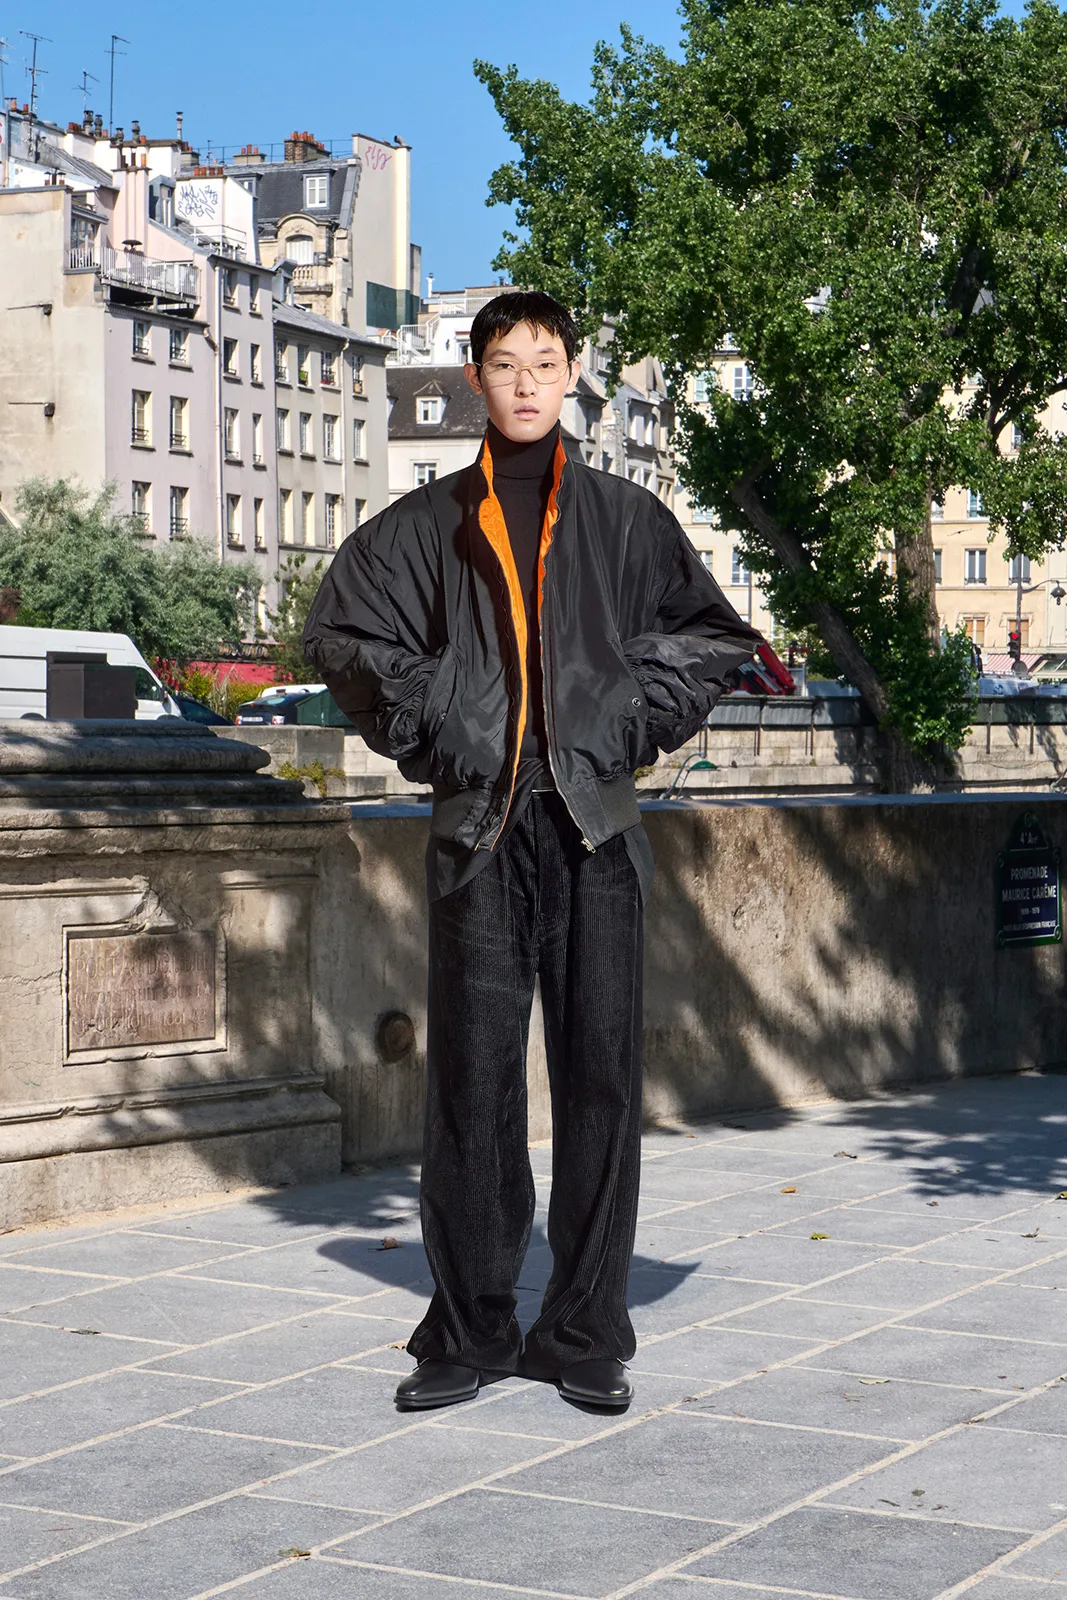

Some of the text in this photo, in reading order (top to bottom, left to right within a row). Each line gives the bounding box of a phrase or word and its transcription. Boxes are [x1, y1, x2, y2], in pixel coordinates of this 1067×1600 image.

[1010, 866, 1048, 881] PROMENADE
[1002, 883, 1057, 902] MAURICE CARÊME
